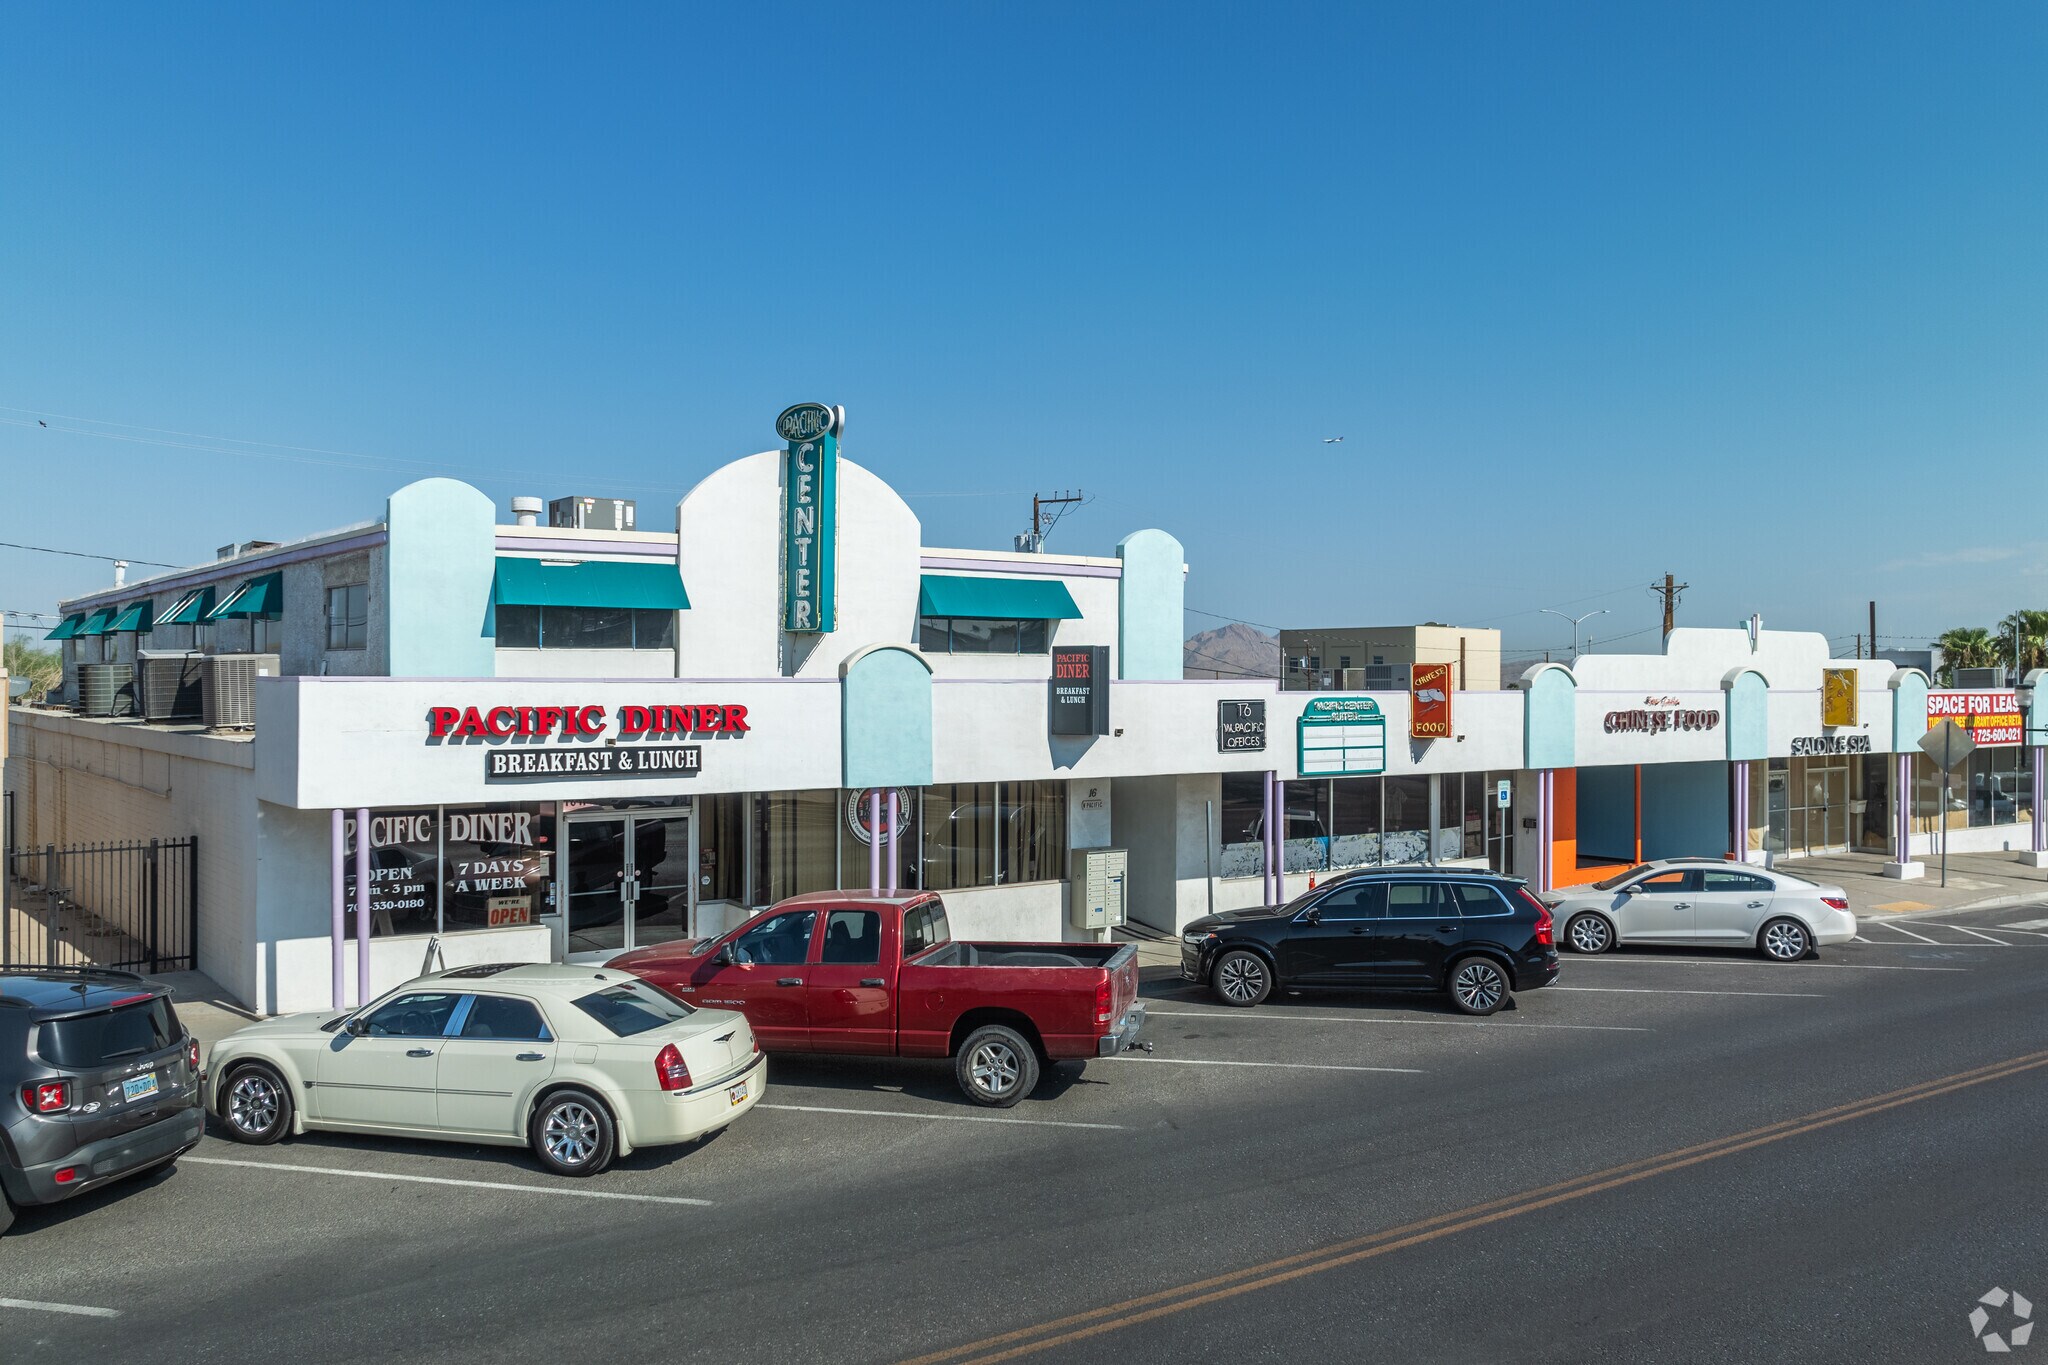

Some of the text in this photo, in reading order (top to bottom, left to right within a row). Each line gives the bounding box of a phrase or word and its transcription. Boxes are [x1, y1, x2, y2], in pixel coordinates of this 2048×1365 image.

[782, 410, 828, 438] PACIFIC
[794, 443, 814, 629] CENTER
[1057, 654, 1090, 662] PACIFIC
[1056, 664, 1090, 678] DINER
[1415, 668, 1444, 686] CHINESE
[1314, 700, 1374, 711] PACIFIC CENTER
[1928, 696, 2019, 714] SPACE FOR LEAS
[430, 704, 751, 738] PACIFIC DINER
[1416, 722, 1446, 732] FOOD
[1606, 710, 1720, 731] CHINESE FOOD
[1991, 716, 2008, 726] OFFICE
[1227, 736, 1260, 747] OFFICES
[1978, 728, 2020, 742] 725-600-021
[1792, 736, 1837, 754] SALON
[1848, 736, 1872, 752] SPA
[493, 750, 698, 774] BREAKFAST & LUNCH
[1089, 788, 1097, 798] 16
[344, 812, 534, 855] PCIFIC DINER
[458, 860, 524, 875] 7 DAYS
[348, 887, 357, 897] 7
[392, 884, 401, 893] 3
[404, 884, 425, 896] pm
[456, 876, 528, 893] A WEEK
[347, 898, 425, 913] 70-330-0180
[490, 907, 528, 925] OPEN
